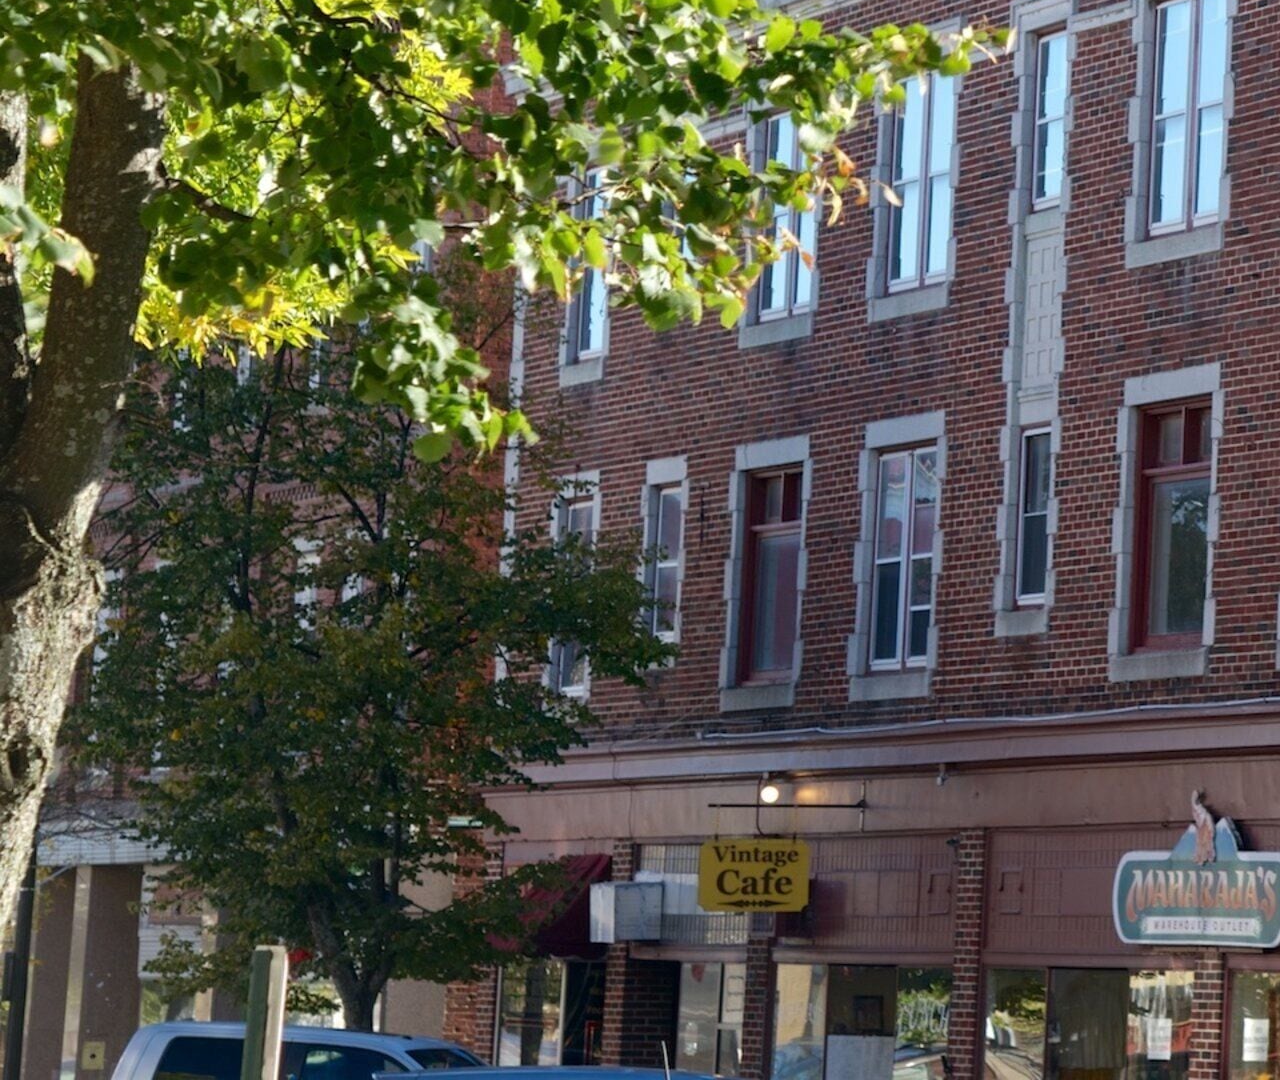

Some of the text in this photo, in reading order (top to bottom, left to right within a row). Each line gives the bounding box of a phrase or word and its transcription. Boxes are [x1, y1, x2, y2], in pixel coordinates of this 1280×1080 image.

[713, 845, 799, 867] Vintage
[716, 868, 793, 896] Cafe
[1126, 866, 1277, 922] MAHARAJA'S
[1154, 919, 1250, 933] WAREHOUSE OUTLET
